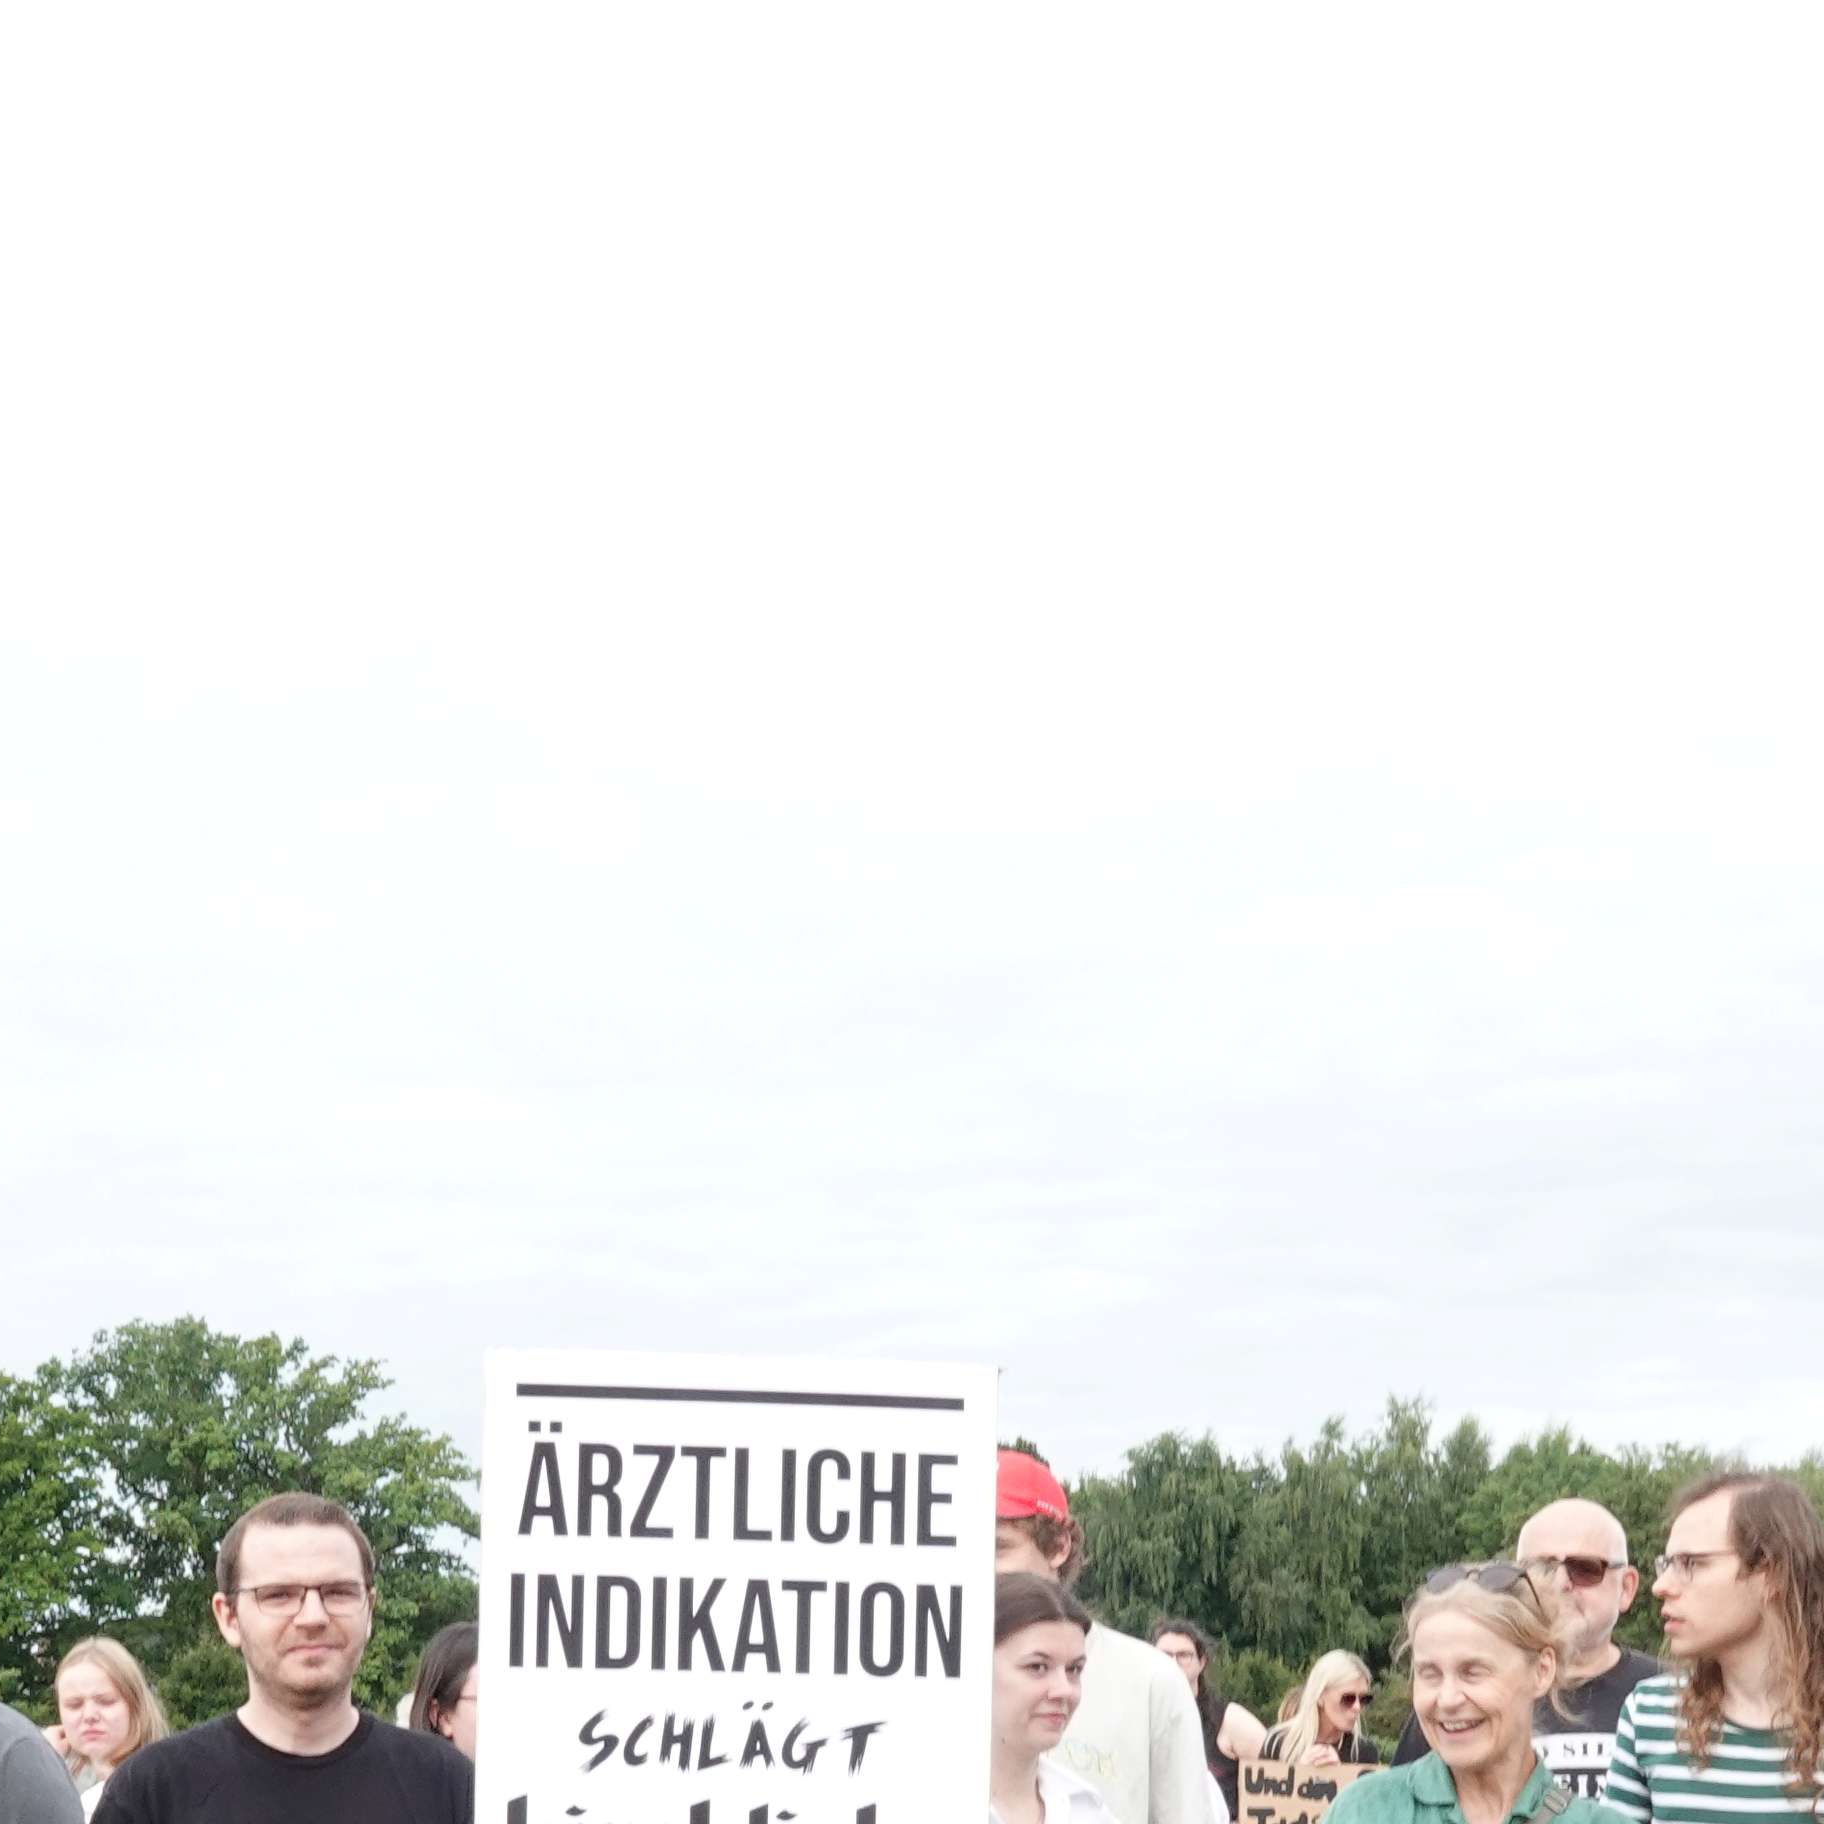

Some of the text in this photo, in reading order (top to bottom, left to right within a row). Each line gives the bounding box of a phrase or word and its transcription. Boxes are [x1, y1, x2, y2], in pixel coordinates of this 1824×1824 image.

[518, 1420, 959, 1547] ÄRZTLICHE
[509, 1573, 963, 1679] INDIKATION
[577, 1701, 888, 1775] SCHLÄGT
[1245, 1765, 1295, 1797] Und
